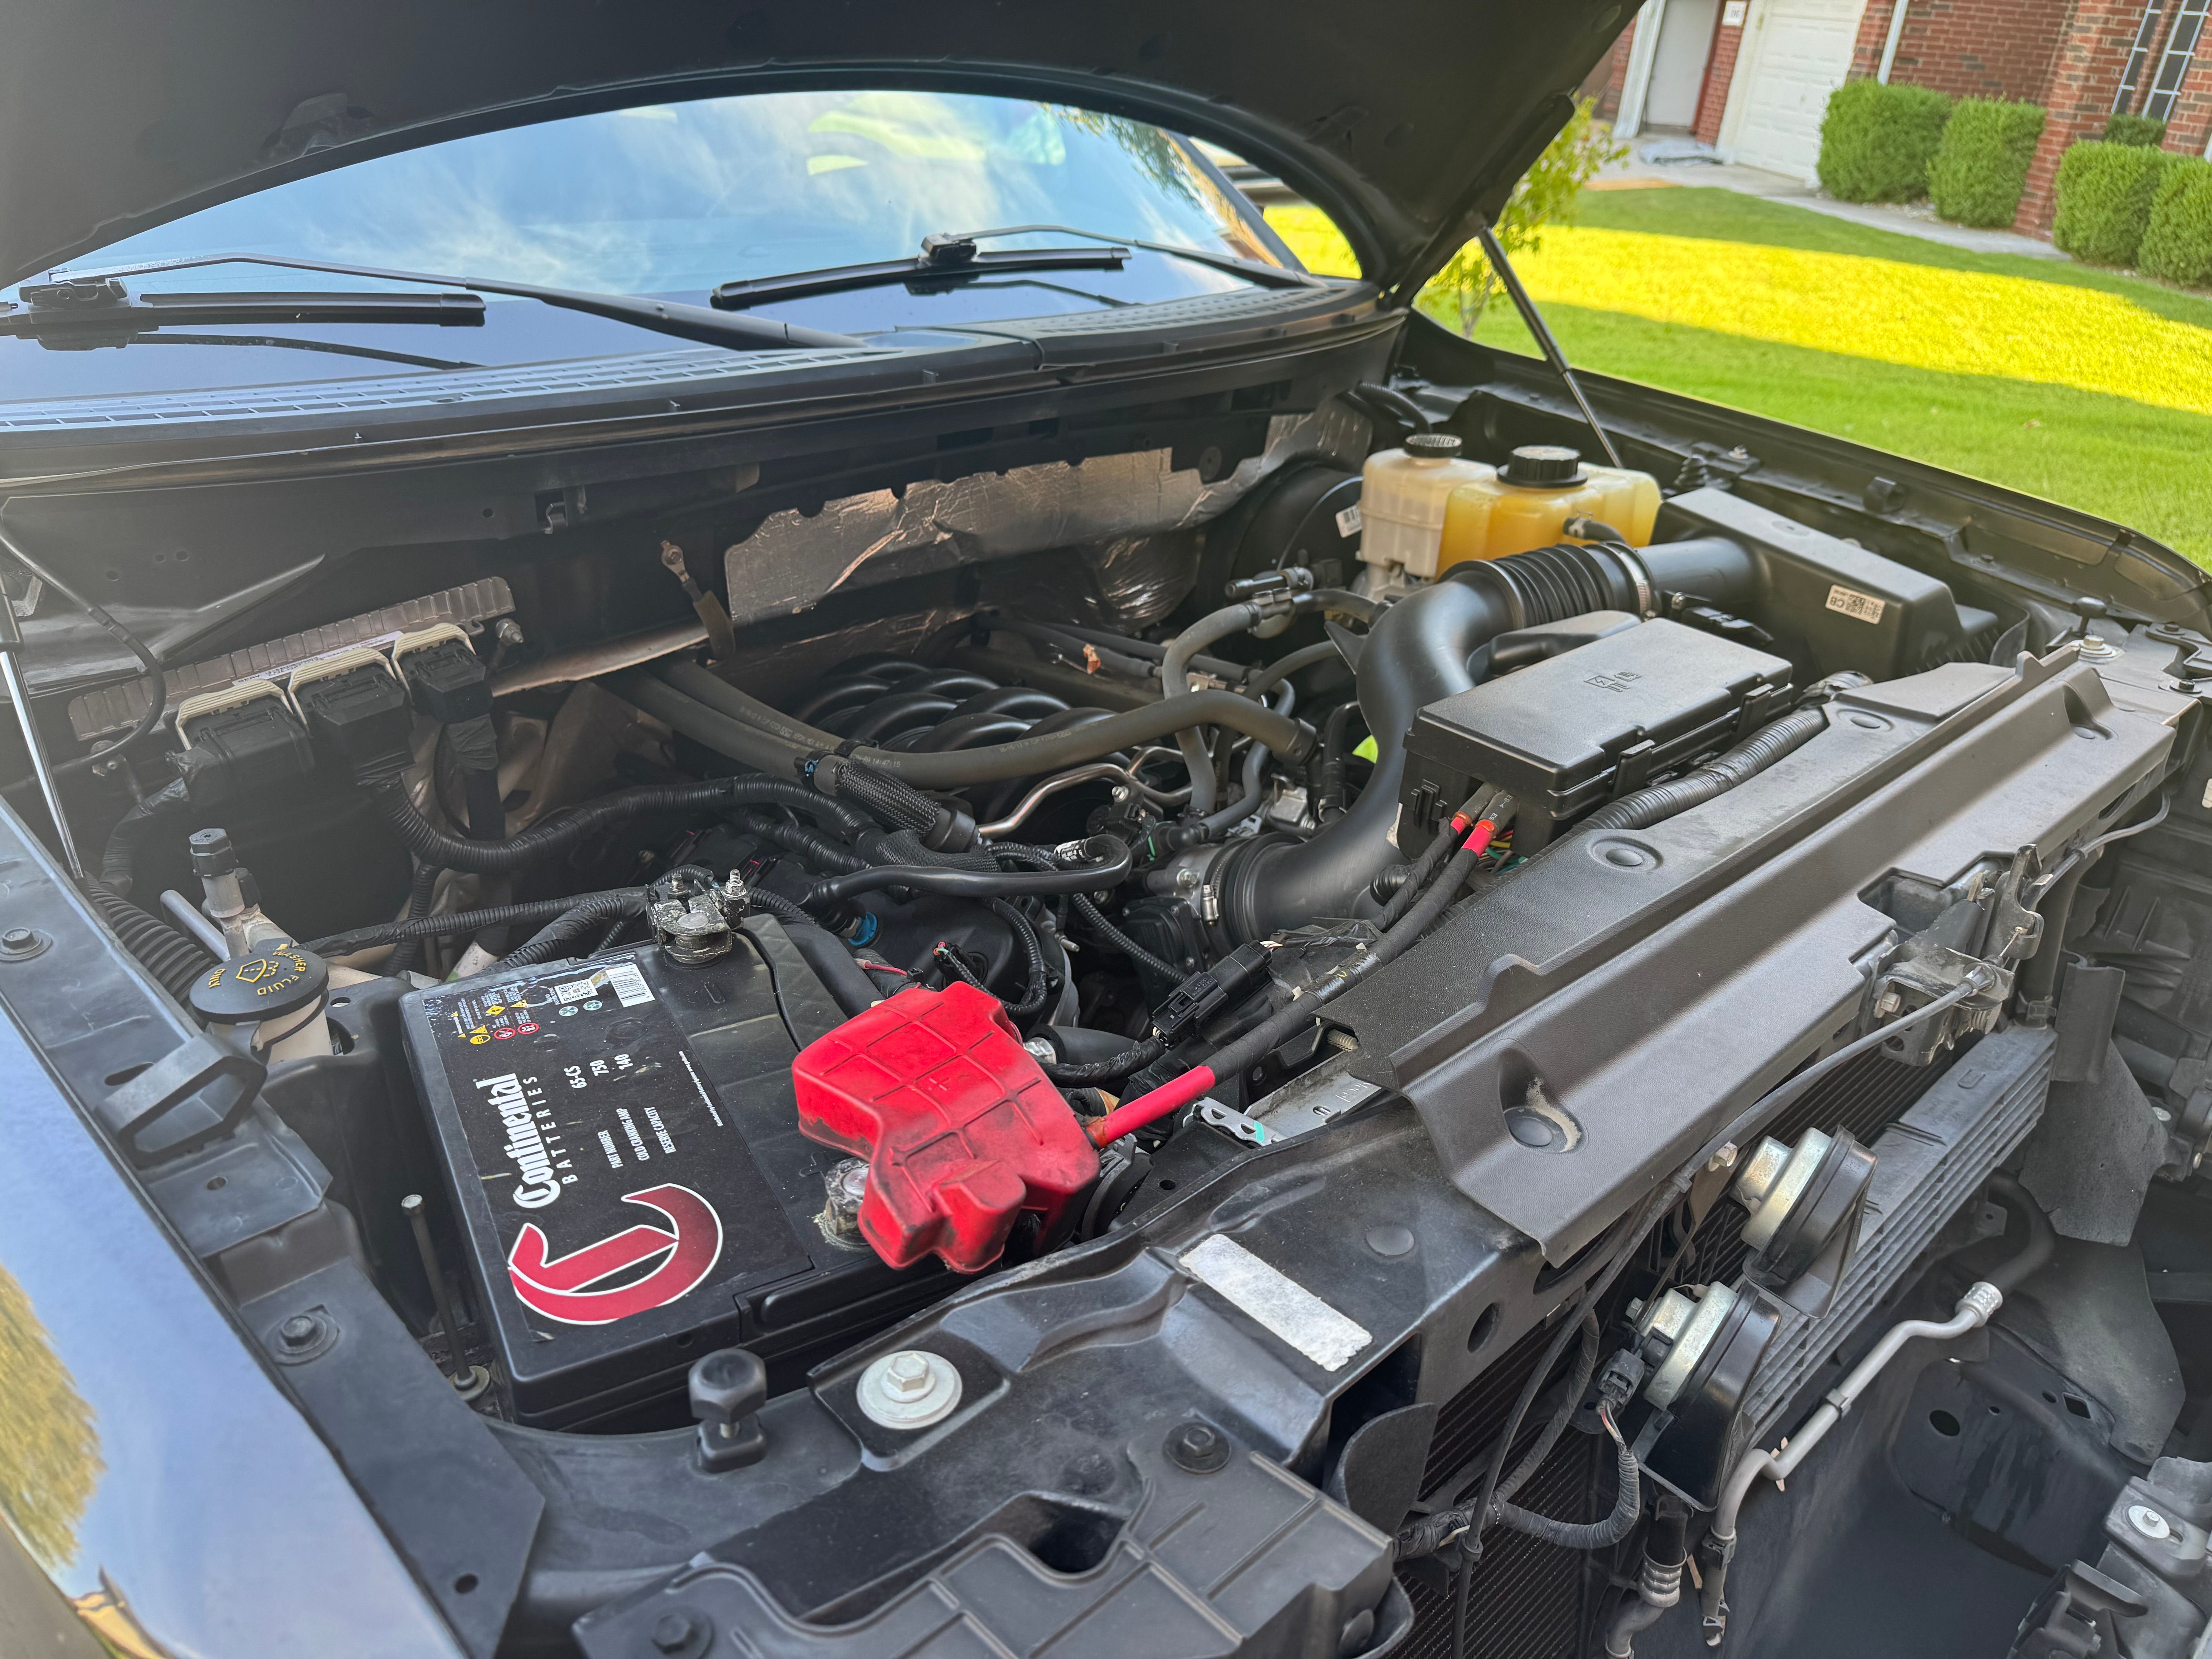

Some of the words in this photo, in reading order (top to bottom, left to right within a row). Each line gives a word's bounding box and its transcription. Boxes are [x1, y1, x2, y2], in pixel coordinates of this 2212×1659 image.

[273, 951, 306, 972] WASHER
[208, 969, 226, 988] ONLY
[257, 975, 299, 996] FLUID
[590, 1060, 609, 1076] 750
[614, 1054, 633, 1070] 140
[564, 1066, 587, 1088] 65-CS
[696, 1082, 705, 1092] Battery
[700, 1092, 713, 1108] Continental
[616, 1108, 631, 1120] AMP
[644, 1106, 665, 1130] CAPACITY
[476, 1073, 560, 1208] Continental
[523, 1077, 578, 1184] BATTERIES
[622, 1119, 643, 1146] CRANKING
[598, 1130, 617, 1154] NUMBER
[656, 1129, 676, 1154] RESERVE
[607, 1154, 623, 1168] PART
[634, 1146, 650, 1161] COLD
